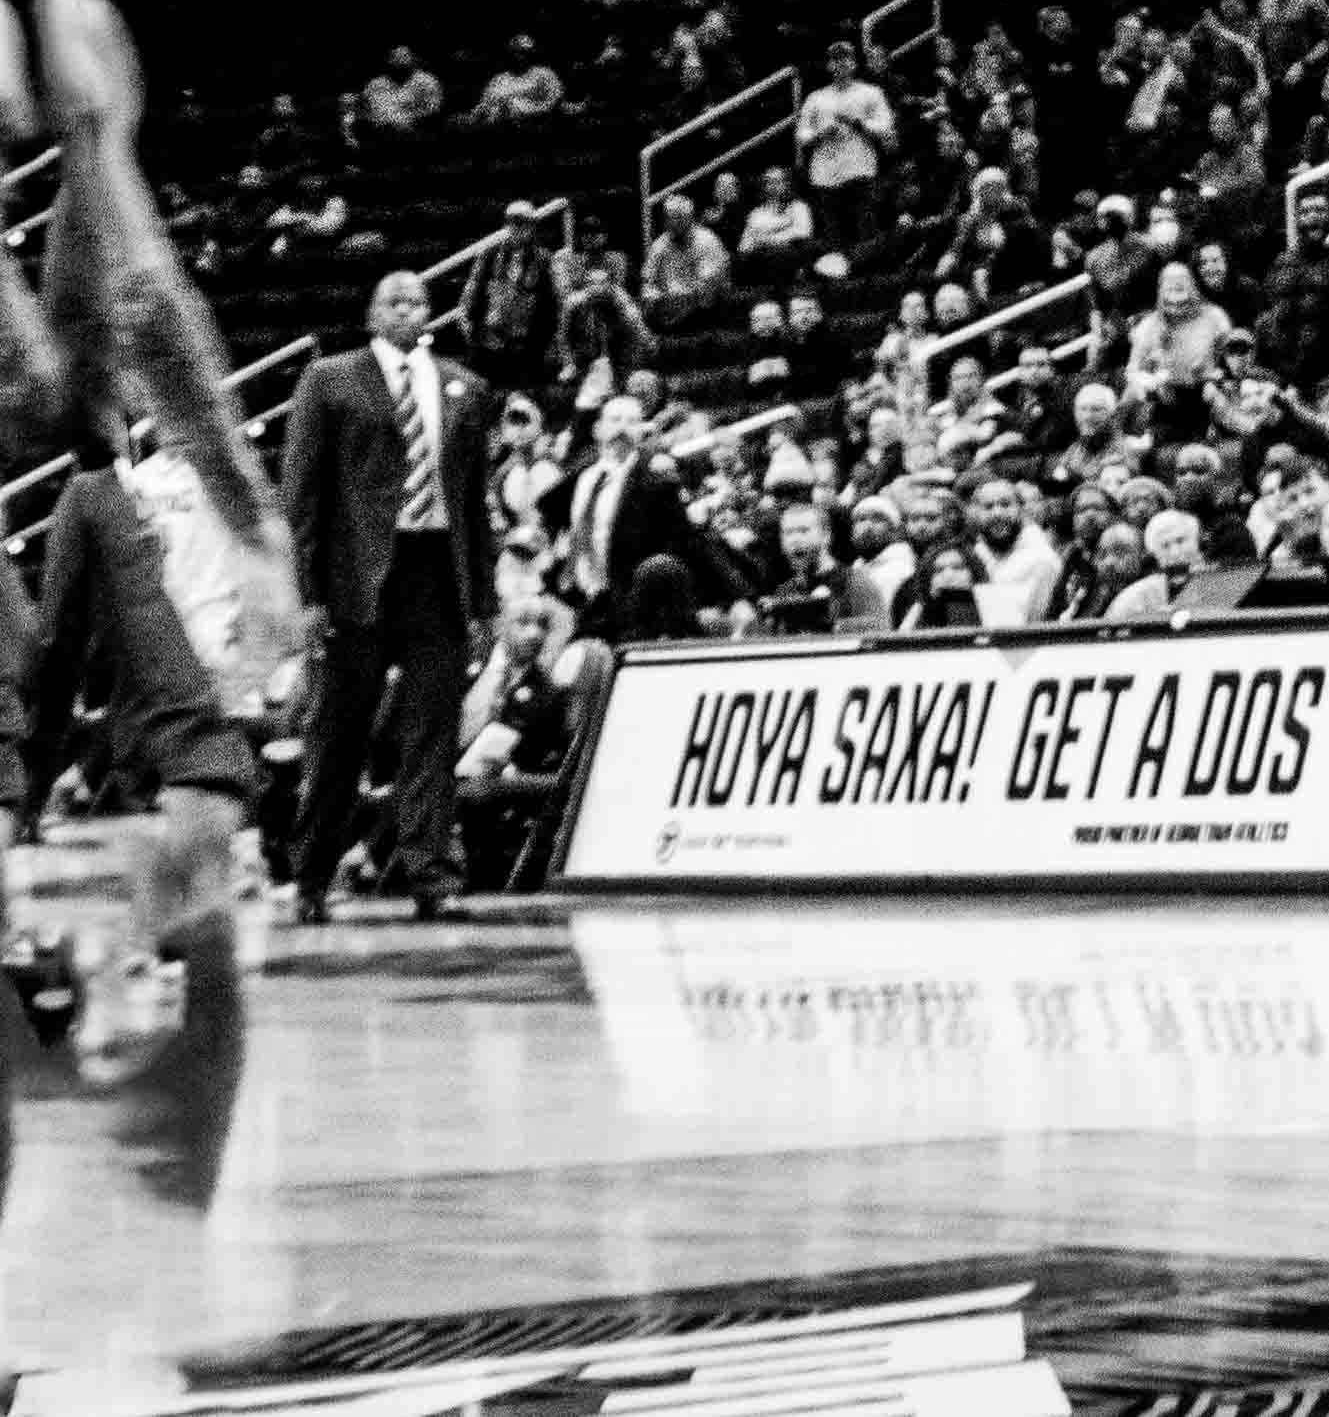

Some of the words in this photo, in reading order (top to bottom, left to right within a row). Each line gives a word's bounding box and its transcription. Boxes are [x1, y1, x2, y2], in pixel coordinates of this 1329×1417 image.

[669, 687, 819, 808] HOYA
[818, 680, 996, 805] SAXA!
[1005, 674, 1135, 801] GET
[1125, 671, 1181, 799] A
[1181, 666, 1326, 798] DOS
